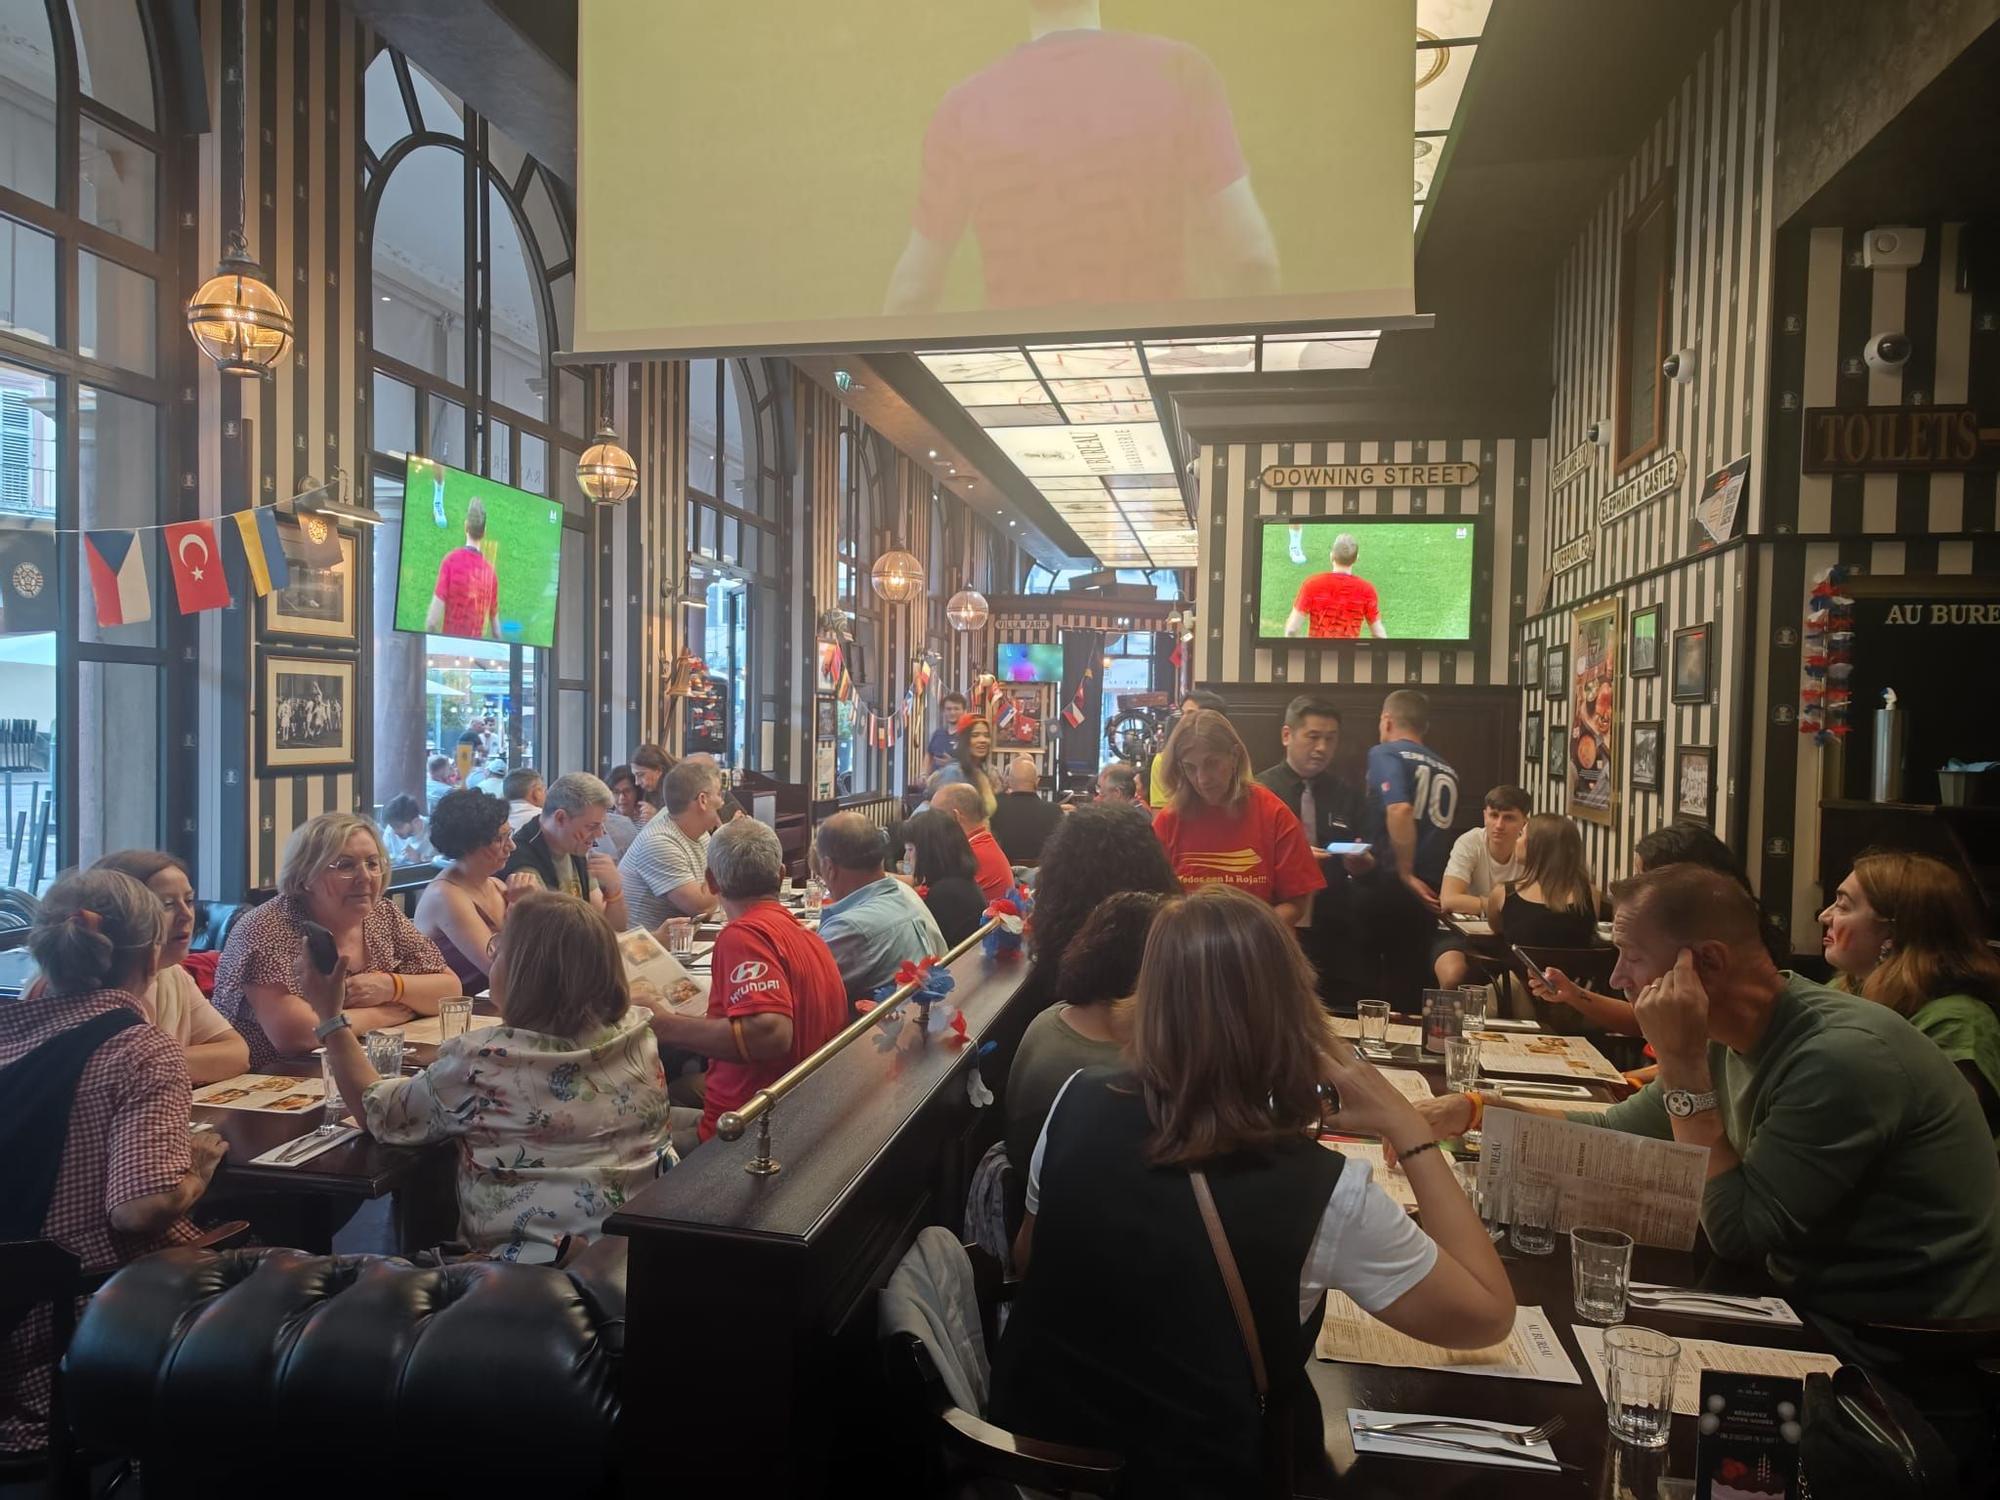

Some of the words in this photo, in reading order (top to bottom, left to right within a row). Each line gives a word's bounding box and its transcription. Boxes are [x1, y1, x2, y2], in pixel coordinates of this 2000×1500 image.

[1817, 411, 1977, 463] TOILETS
[1273, 469, 1374, 486] DOWNING
[1384, 466, 1468, 484] STREET
[1601, 486, 1635, 520] ELEPHANT
[1643, 458, 1674, 498] CASTLE
[999, 621, 1021, 629] VILLA
[1885, 604, 1923, 625] AU
[1414, 764, 1459, 829] 10
[1225, 874, 1235, 883] la
[730, 980, 780, 1004] HYUNDAI
